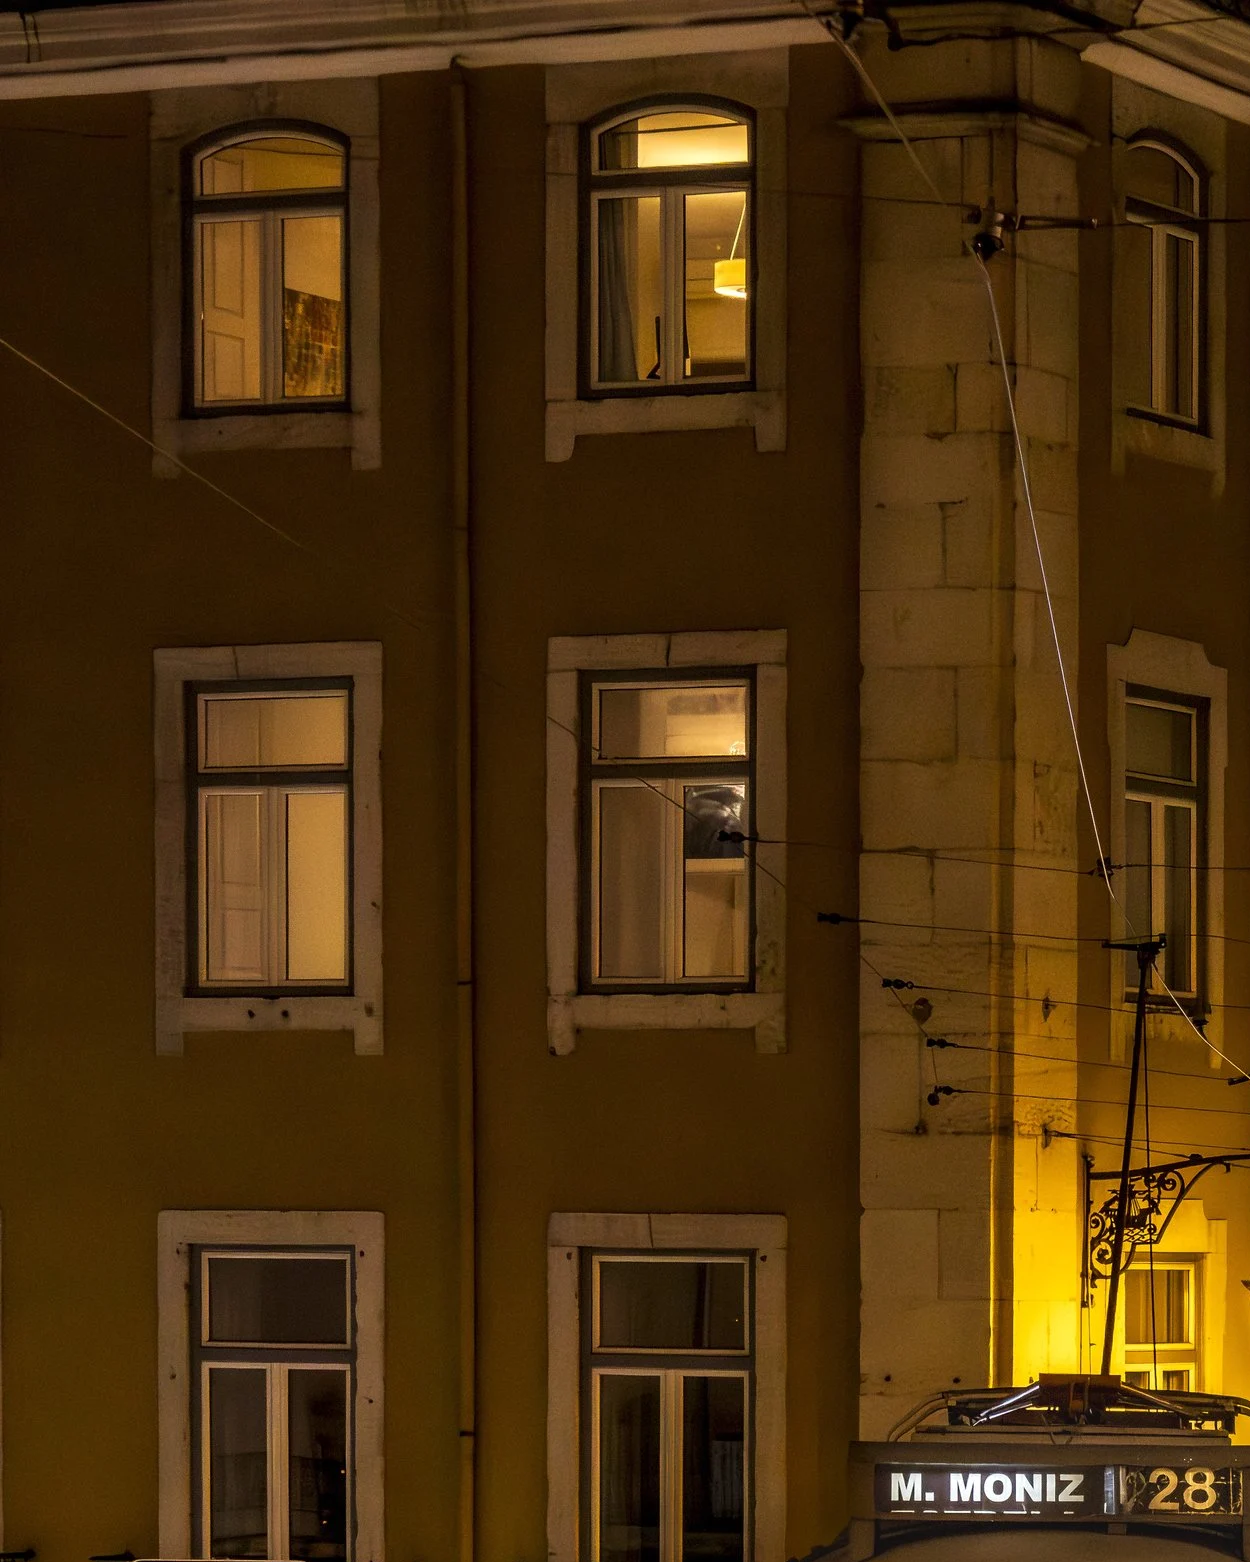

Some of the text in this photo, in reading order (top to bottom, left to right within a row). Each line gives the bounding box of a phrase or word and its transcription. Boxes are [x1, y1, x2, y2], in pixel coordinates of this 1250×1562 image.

[891, 1473, 1085, 1502] M. MONIZ
[1148, 1467, 1218, 1511] 28
